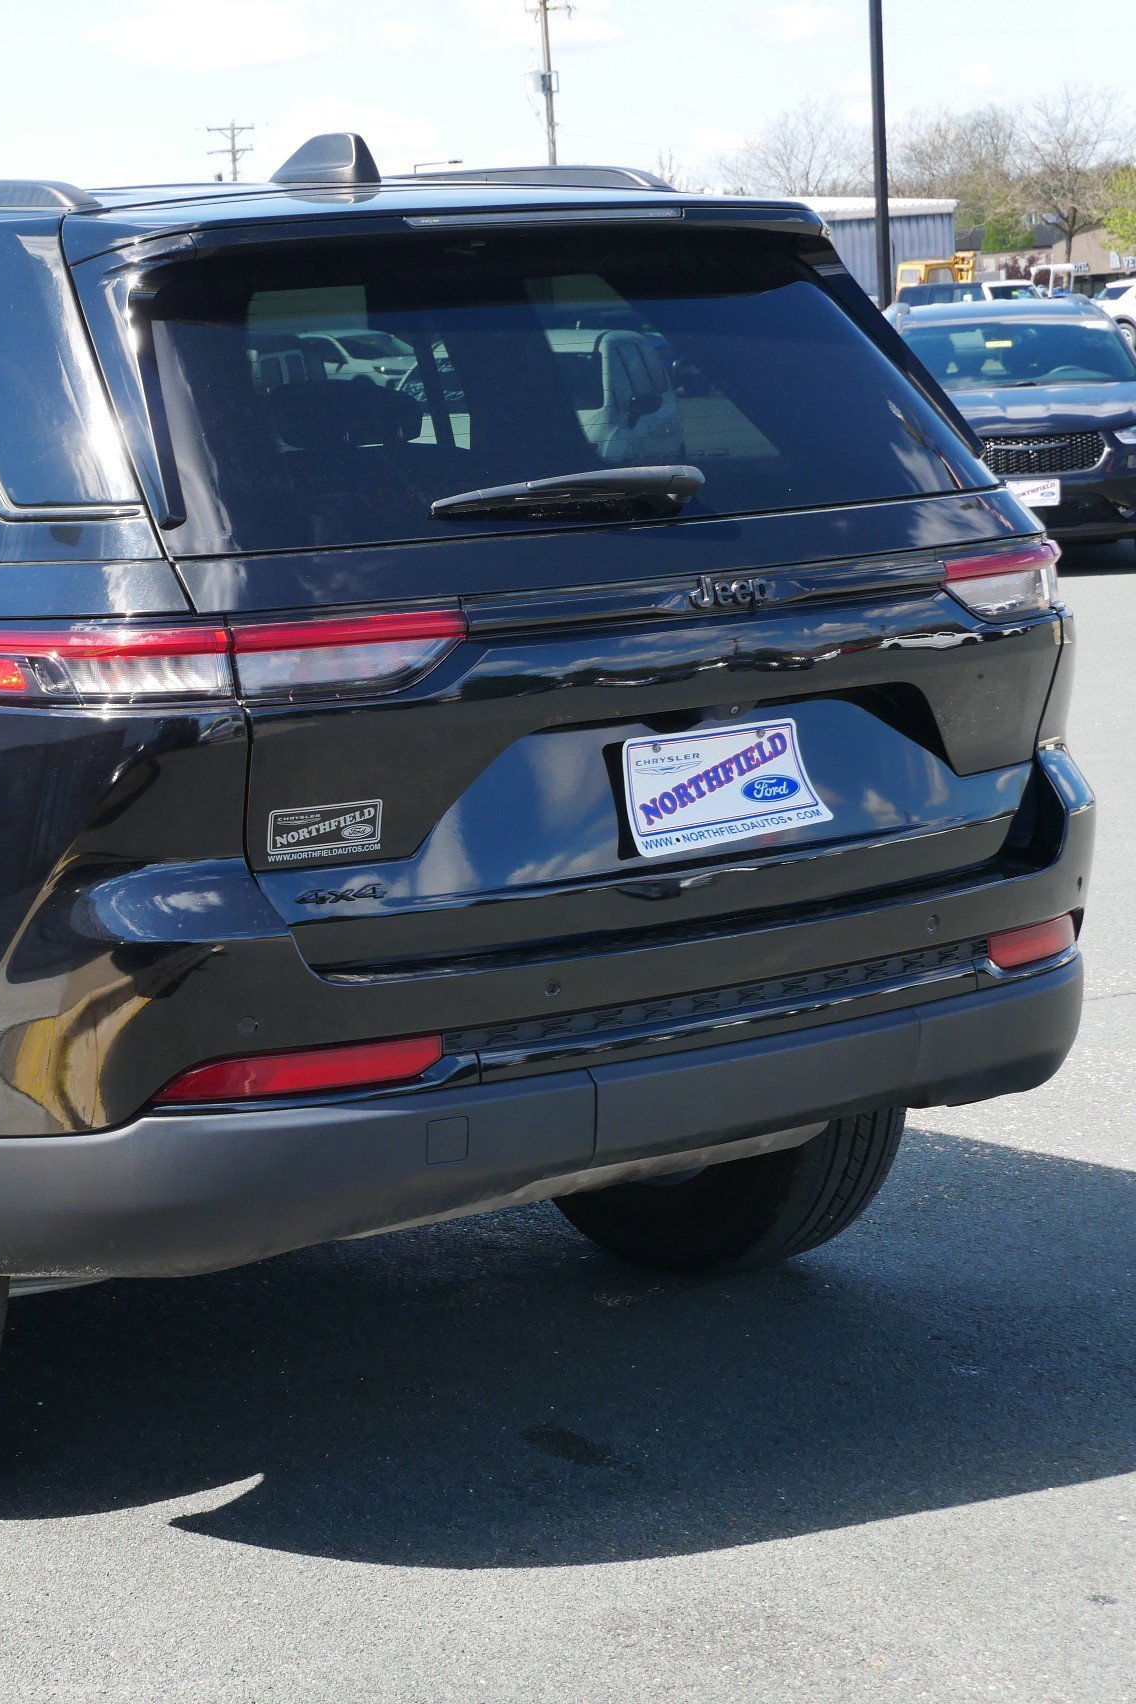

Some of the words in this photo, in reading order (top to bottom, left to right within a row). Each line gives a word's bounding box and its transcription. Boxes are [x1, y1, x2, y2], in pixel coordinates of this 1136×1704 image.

[689, 575, 768, 612] Jeep
[635, 752, 700, 767] CHRYSLER
[639, 732, 788, 826] NORTHFIELD
[753, 779, 789, 798] Ford
[275, 807, 375, 848] NORTHFIELD
[277, 813, 321, 822] CHRYSLER
[268, 843, 381, 863] WWW.NORTHFIELDAUTOS.COM
[294, 883, 388, 905] 4x4
